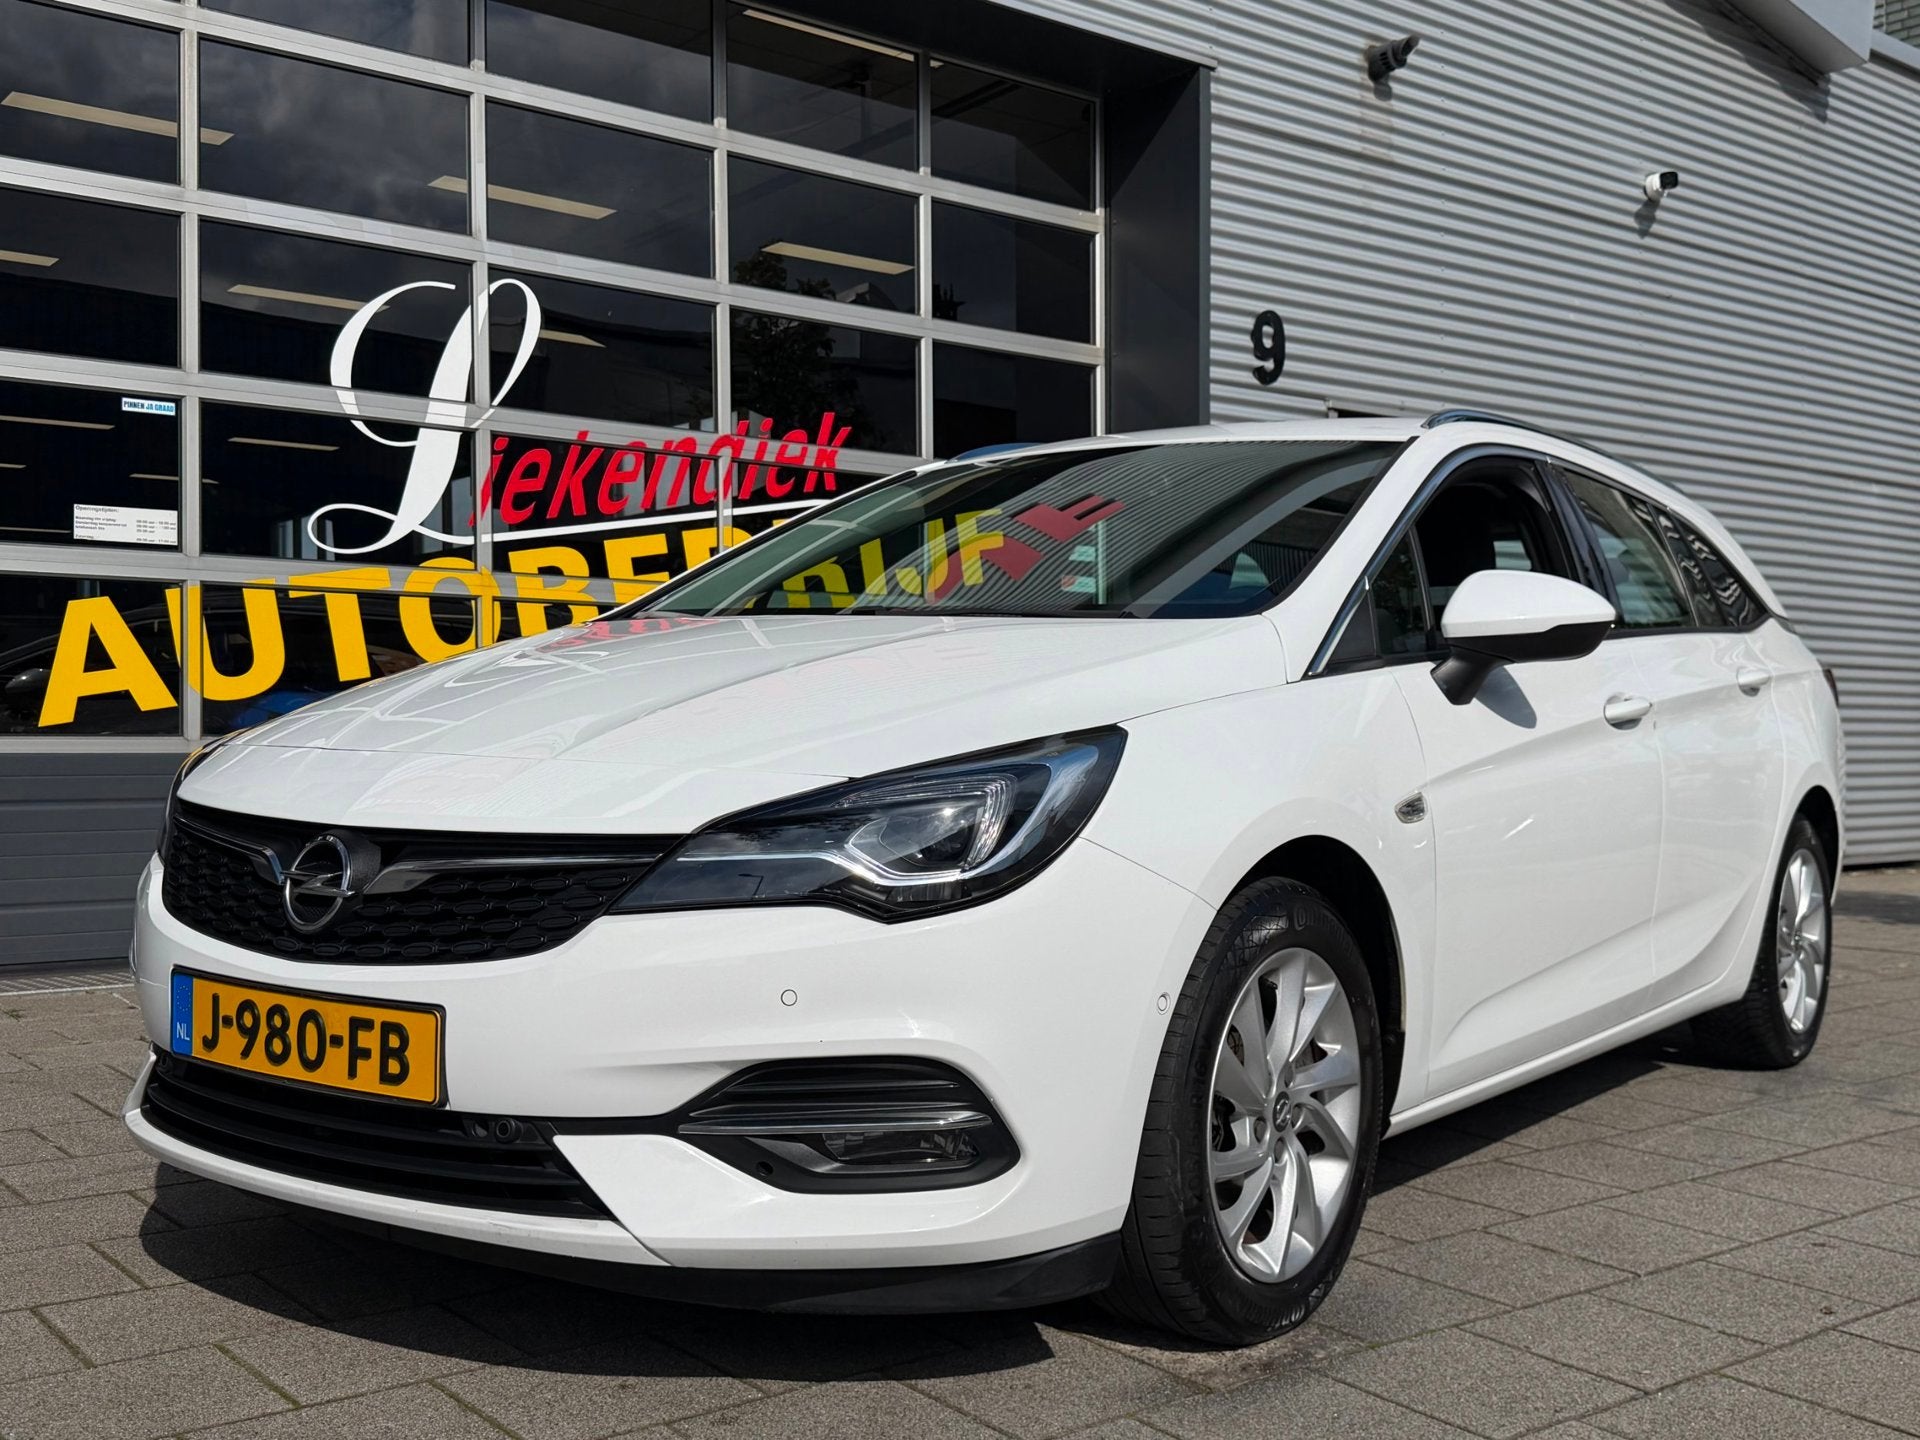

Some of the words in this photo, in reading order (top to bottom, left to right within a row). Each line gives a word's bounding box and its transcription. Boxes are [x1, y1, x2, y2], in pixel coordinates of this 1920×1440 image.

[1251, 310, 1286, 386] 9
[123, 400, 145, 410] PINNEN
[176, 1021, 190, 1042] NL
[202, 992, 411, 1087] J-980-FB
